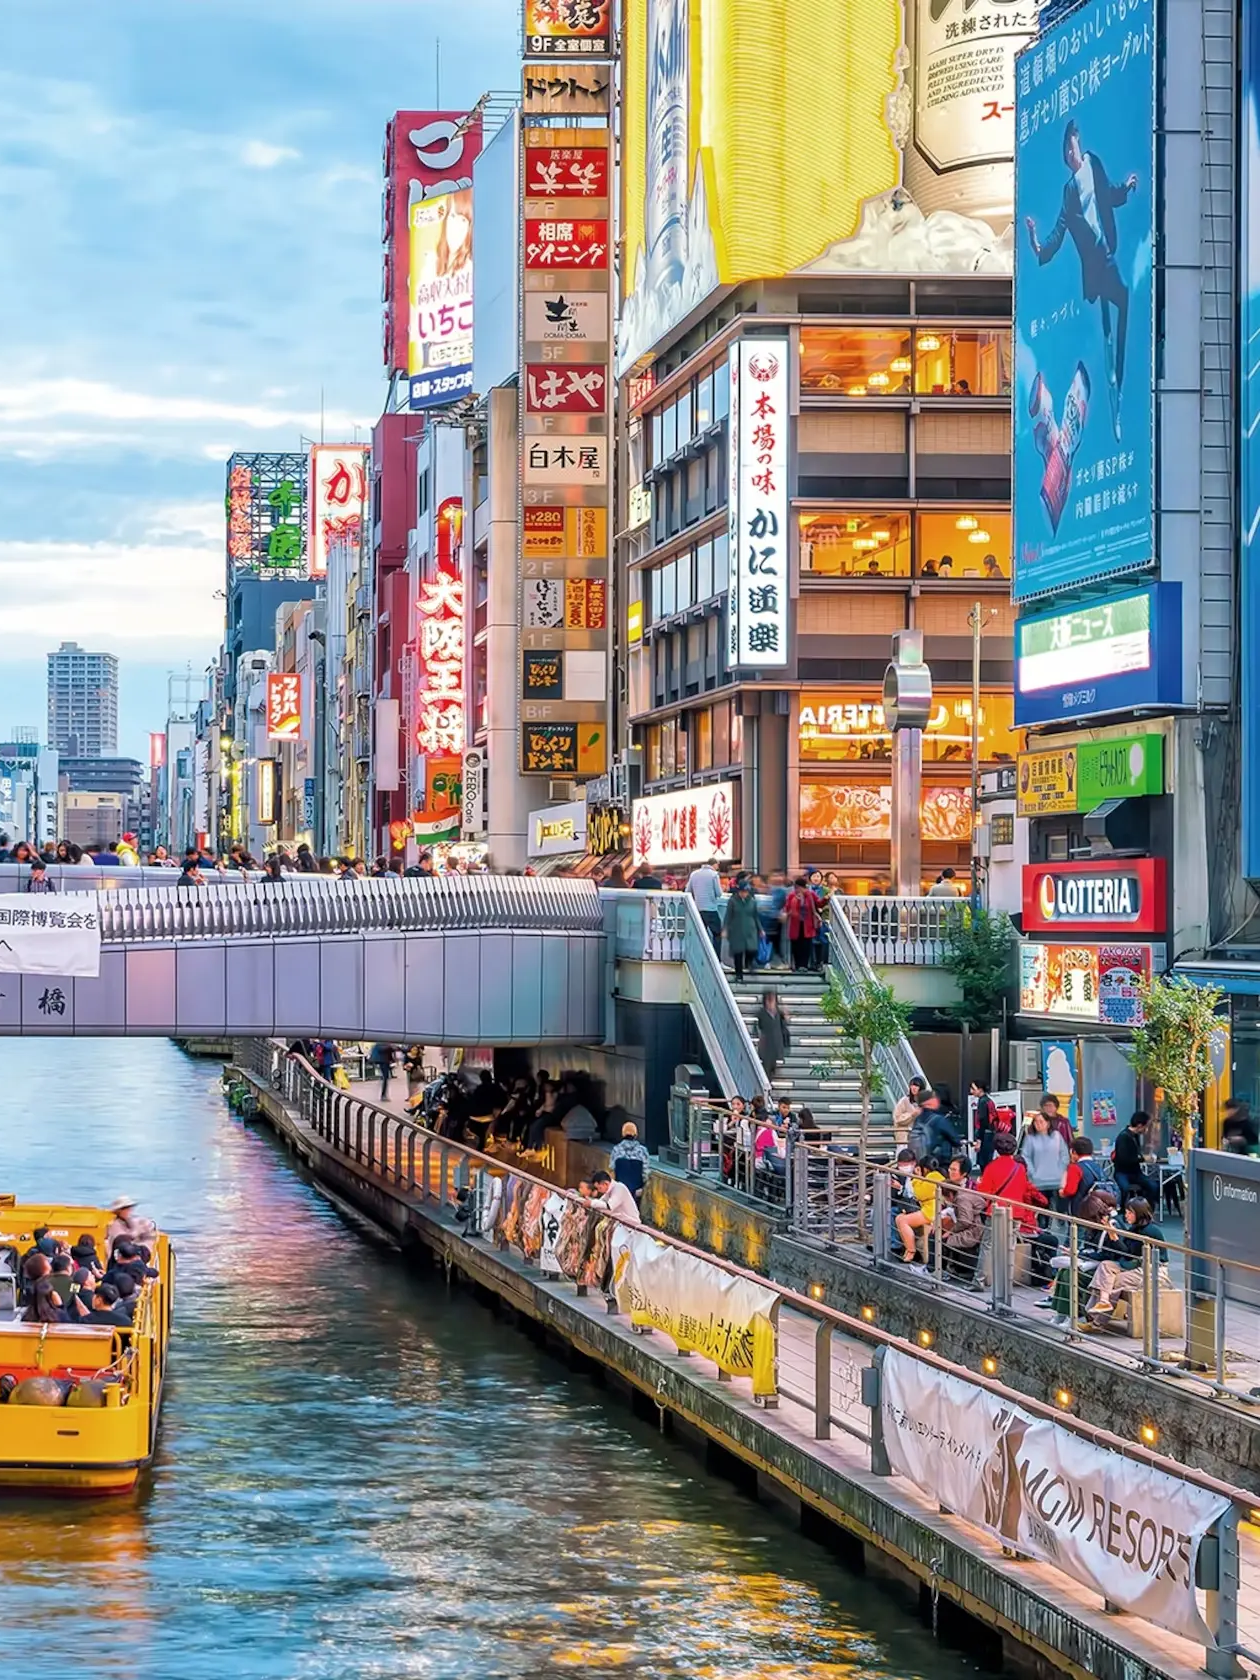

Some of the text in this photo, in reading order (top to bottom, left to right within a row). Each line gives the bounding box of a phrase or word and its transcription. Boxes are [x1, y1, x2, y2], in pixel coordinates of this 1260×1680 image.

[531, 35, 552, 52] 9F
[948, 50, 974, 64] SUPER
[975, 47, 995, 58] DRY
[943, 74, 1005, 93] INGREDIENTS
[959, 84, 1005, 98] ADVANCED
[538, 222, 574, 242] 相席
[526, 242, 607, 266] ダイニング
[542, 346, 564, 360] 5F
[749, 390, 778, 497] 本場の味
[529, 442, 600, 470] 白木屋
[527, 562, 554, 576] 2F
[527, 634, 553, 647] 1F
[415, 571, 464, 756] 大阪王将
[270, 683, 282, 724] ドラッグ
[282, 676, 298, 715] ツルハ
[529, 733, 572, 752] びっくり
[527, 752, 575, 770] ドンキー
[466, 770, 477, 801] ZERO
[1058, 877, 1132, 914] LOTTERIA
[1222, 1175, 1258, 1204] information
[1019, 1458, 1085, 1534] MGM
